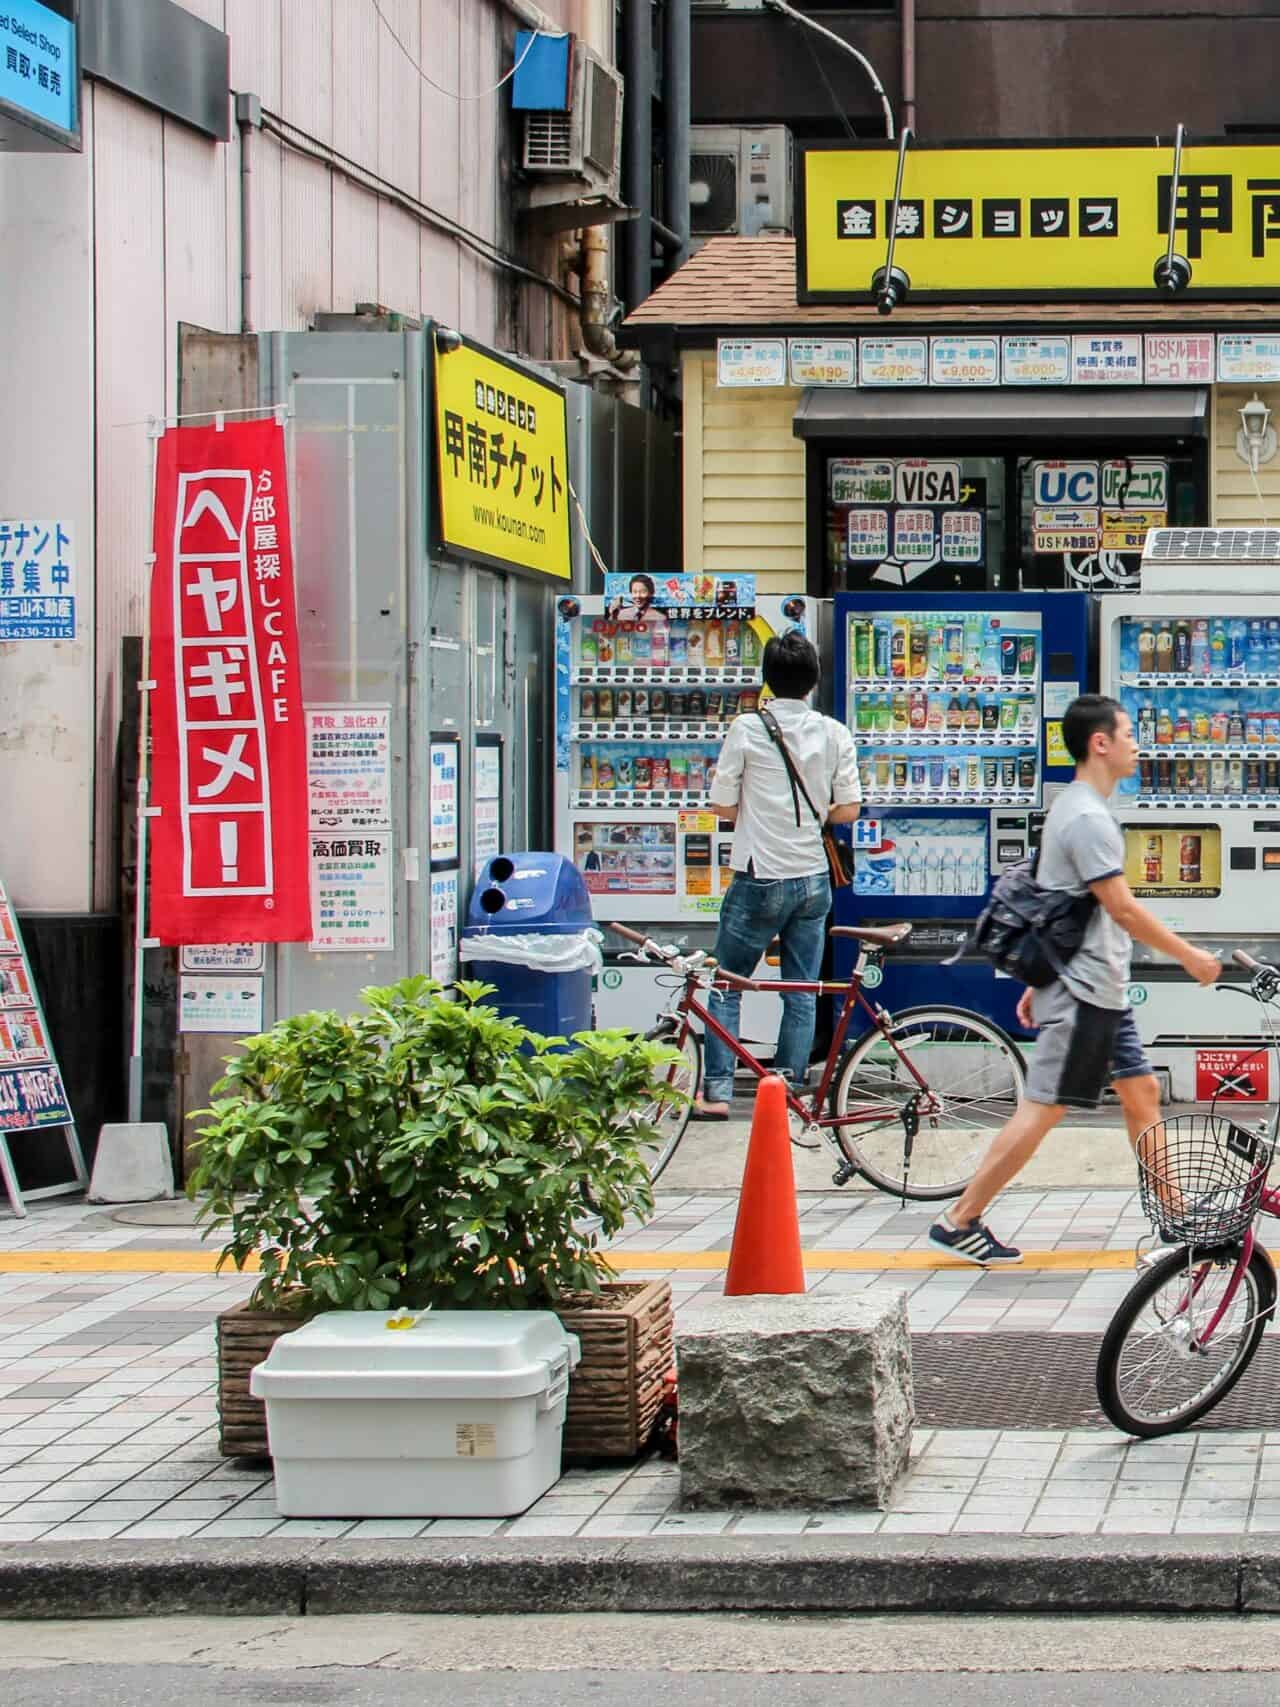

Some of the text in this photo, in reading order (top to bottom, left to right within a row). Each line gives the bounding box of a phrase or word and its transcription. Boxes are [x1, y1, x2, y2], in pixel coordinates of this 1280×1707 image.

[11, 17, 37, 47] Select
[39, 33, 61, 63] Shop
[6, 45, 61, 97] 買取・販売
[840, 202, 1117, 237] 金券ショップ
[475, 379, 537, 435] 金券ショップ
[445, 410, 562, 513] 甲南チケット
[902, 471, 956, 502] VISA
[1040, 471, 1095, 503] UC
[472, 504, 546, 545] www.kounan.com
[0, 560, 70, 595] 募集中
[251, 469, 289, 722] お部屋探しCAFE
[668, 607, 752, 620] 世界をブレンド。
[312, 840, 382, 857] 高価買取
